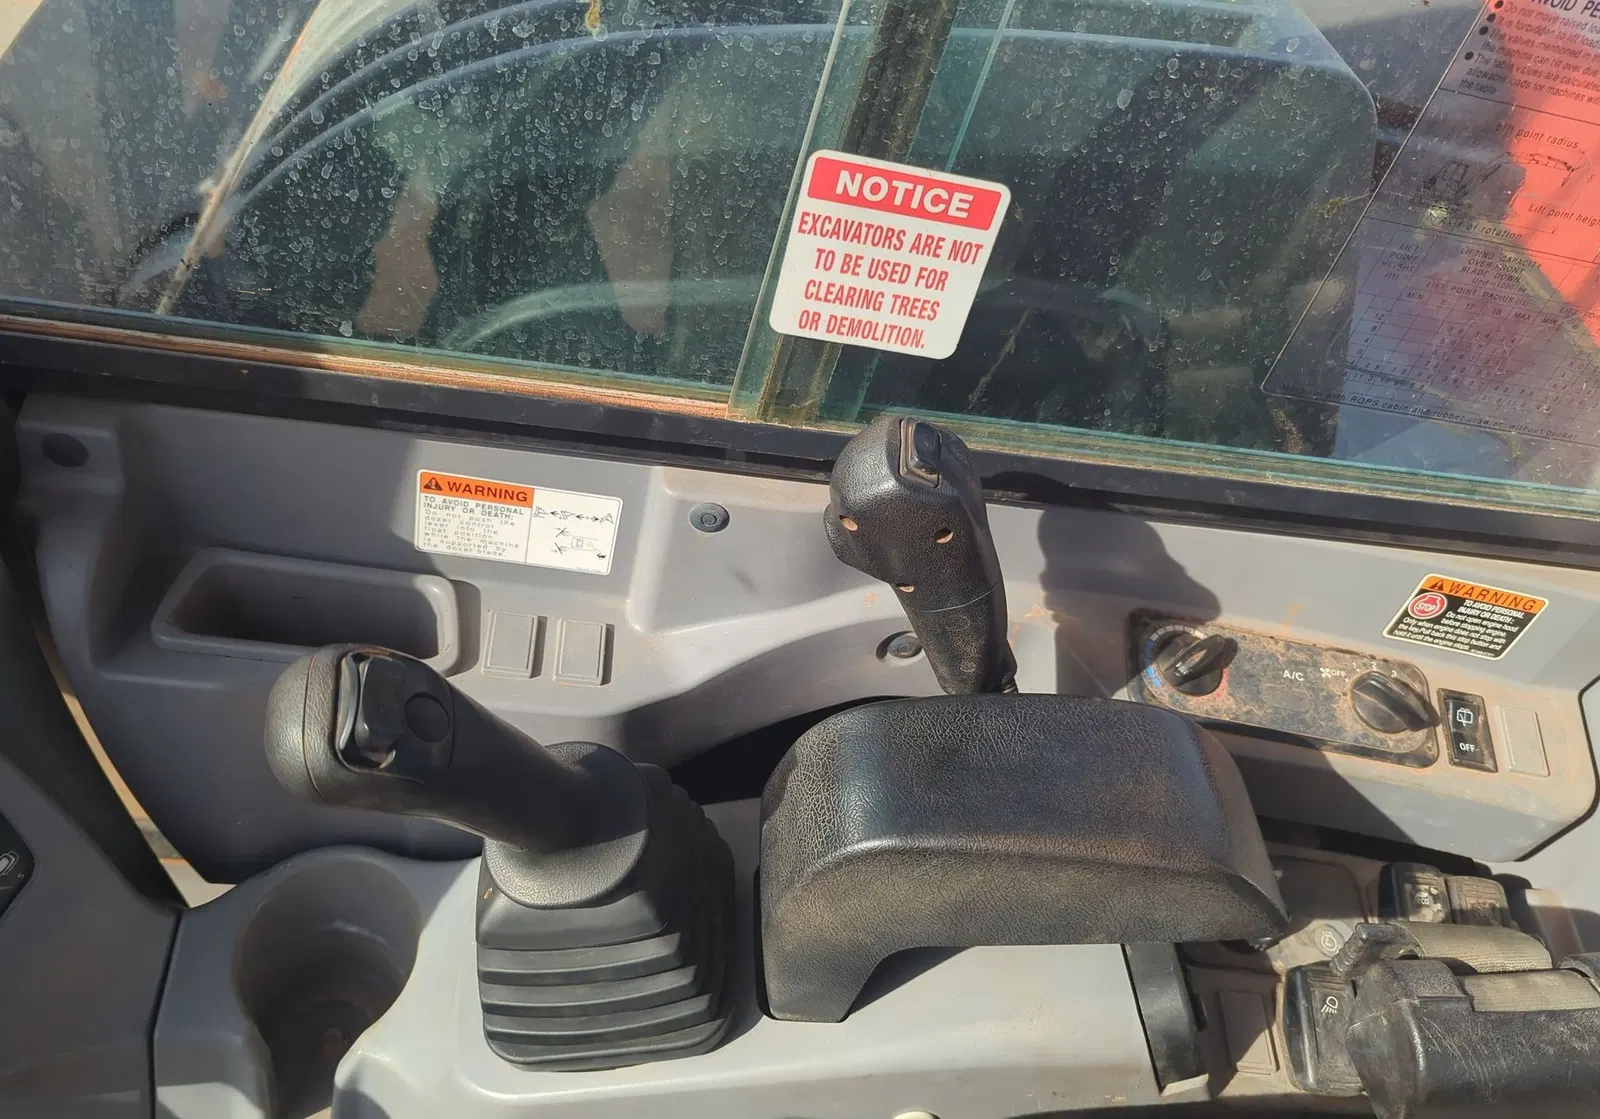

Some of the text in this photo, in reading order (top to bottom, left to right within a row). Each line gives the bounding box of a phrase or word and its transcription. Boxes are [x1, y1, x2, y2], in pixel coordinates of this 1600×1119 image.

[1520, 8, 1532, 17] not
[1536, 12, 1559, 24] move
[1531, 0, 1600, 18] OID PE
[1515, 20, 1556, 36] forbidden
[1556, 31, 1566, 40] to
[1536, 41, 1581, 58] mentioned
[1476, 54, 1491, 65] The
[1544, 72, 1560, 81] are
[1533, 55, 1550, 64] can
[1563, 62, 1582, 72] over
[1582, 66, 1599, 77] due
[1459, 79, 1472, 89] the
[1546, 86, 1585, 102] machines
[1516, 128, 1545, 141] point
[1546, 132, 1579, 149] radius
[835, 170, 973, 218] NOTICE
[1528, 203, 1546, 214] Lift
[1548, 207, 1576, 220] point
[798, 212, 983, 265] EXCAVATORS ARE NOT
[1481, 226, 1522, 240] rotation
[1460, 248, 1542, 270] LIFTING CAPACITY
[1468, 258, 1494, 269] OVER
[814, 248, 949, 291] TO BE USED FOR
[1460, 266, 1521, 283] BLADE DOWN
[804, 280, 940, 321] CLEARING TREES
[1450, 285, 1477, 296] POINT
[1482, 291, 1514, 303] RADIUS
[1407, 292, 1531, 320] MIN MAX
[798, 310, 924, 348] OR DEMOLITION.
[1350, 394, 1378, 406] ROPS
[1382, 403, 1409, 412] cabin
[1508, 422, 1544, 434] without
[447, 481, 528, 502] WARNING
[424, 502, 456, 511] INJURY
[482, 510, 514, 520] DEATH:
[442, 498, 469, 507] AVOID
[476, 502, 524, 515] PERSONAL
[425, 515, 494, 529] dozer control
[454, 530, 493, 540] position
[480, 539, 519, 548] machine
[440, 539, 488, 550] supported
[1449, 582, 1536, 611] WARNING
[1416, 602, 1436, 612] STOP
[1457, 606, 1481, 616] INJURY
[1480, 611, 1491, 619] OR
[1472, 601, 1492, 610] AVOID
[1491, 606, 1524, 619] PERSONAL
[1403, 616, 1418, 626] Only
[1417, 620, 1434, 628] when
[1434, 624, 1454, 634] engine
[1454, 628, 1469, 636] does
[1480, 634, 1493, 642] stop
[1441, 618, 1461, 627] before
[1460, 623, 1486, 634] stopping
[1446, 611, 1456, 619] Do
[1466, 617, 1482, 625] open
[1482, 620, 1502, 630] engine
[1502, 624, 1519, 632] hood
[1393, 629, 1407, 637] hold
[1433, 639, 1454, 647] engine
[1431, 630, 1446, 638] back
[1456, 636, 1471, 644] stop
[1470, 639, 1489, 648] button
[1283, 670, 1304, 682] A/C
[1330, 669, 1346, 678] OFF
[1460, 742, 1475, 752] OFF
